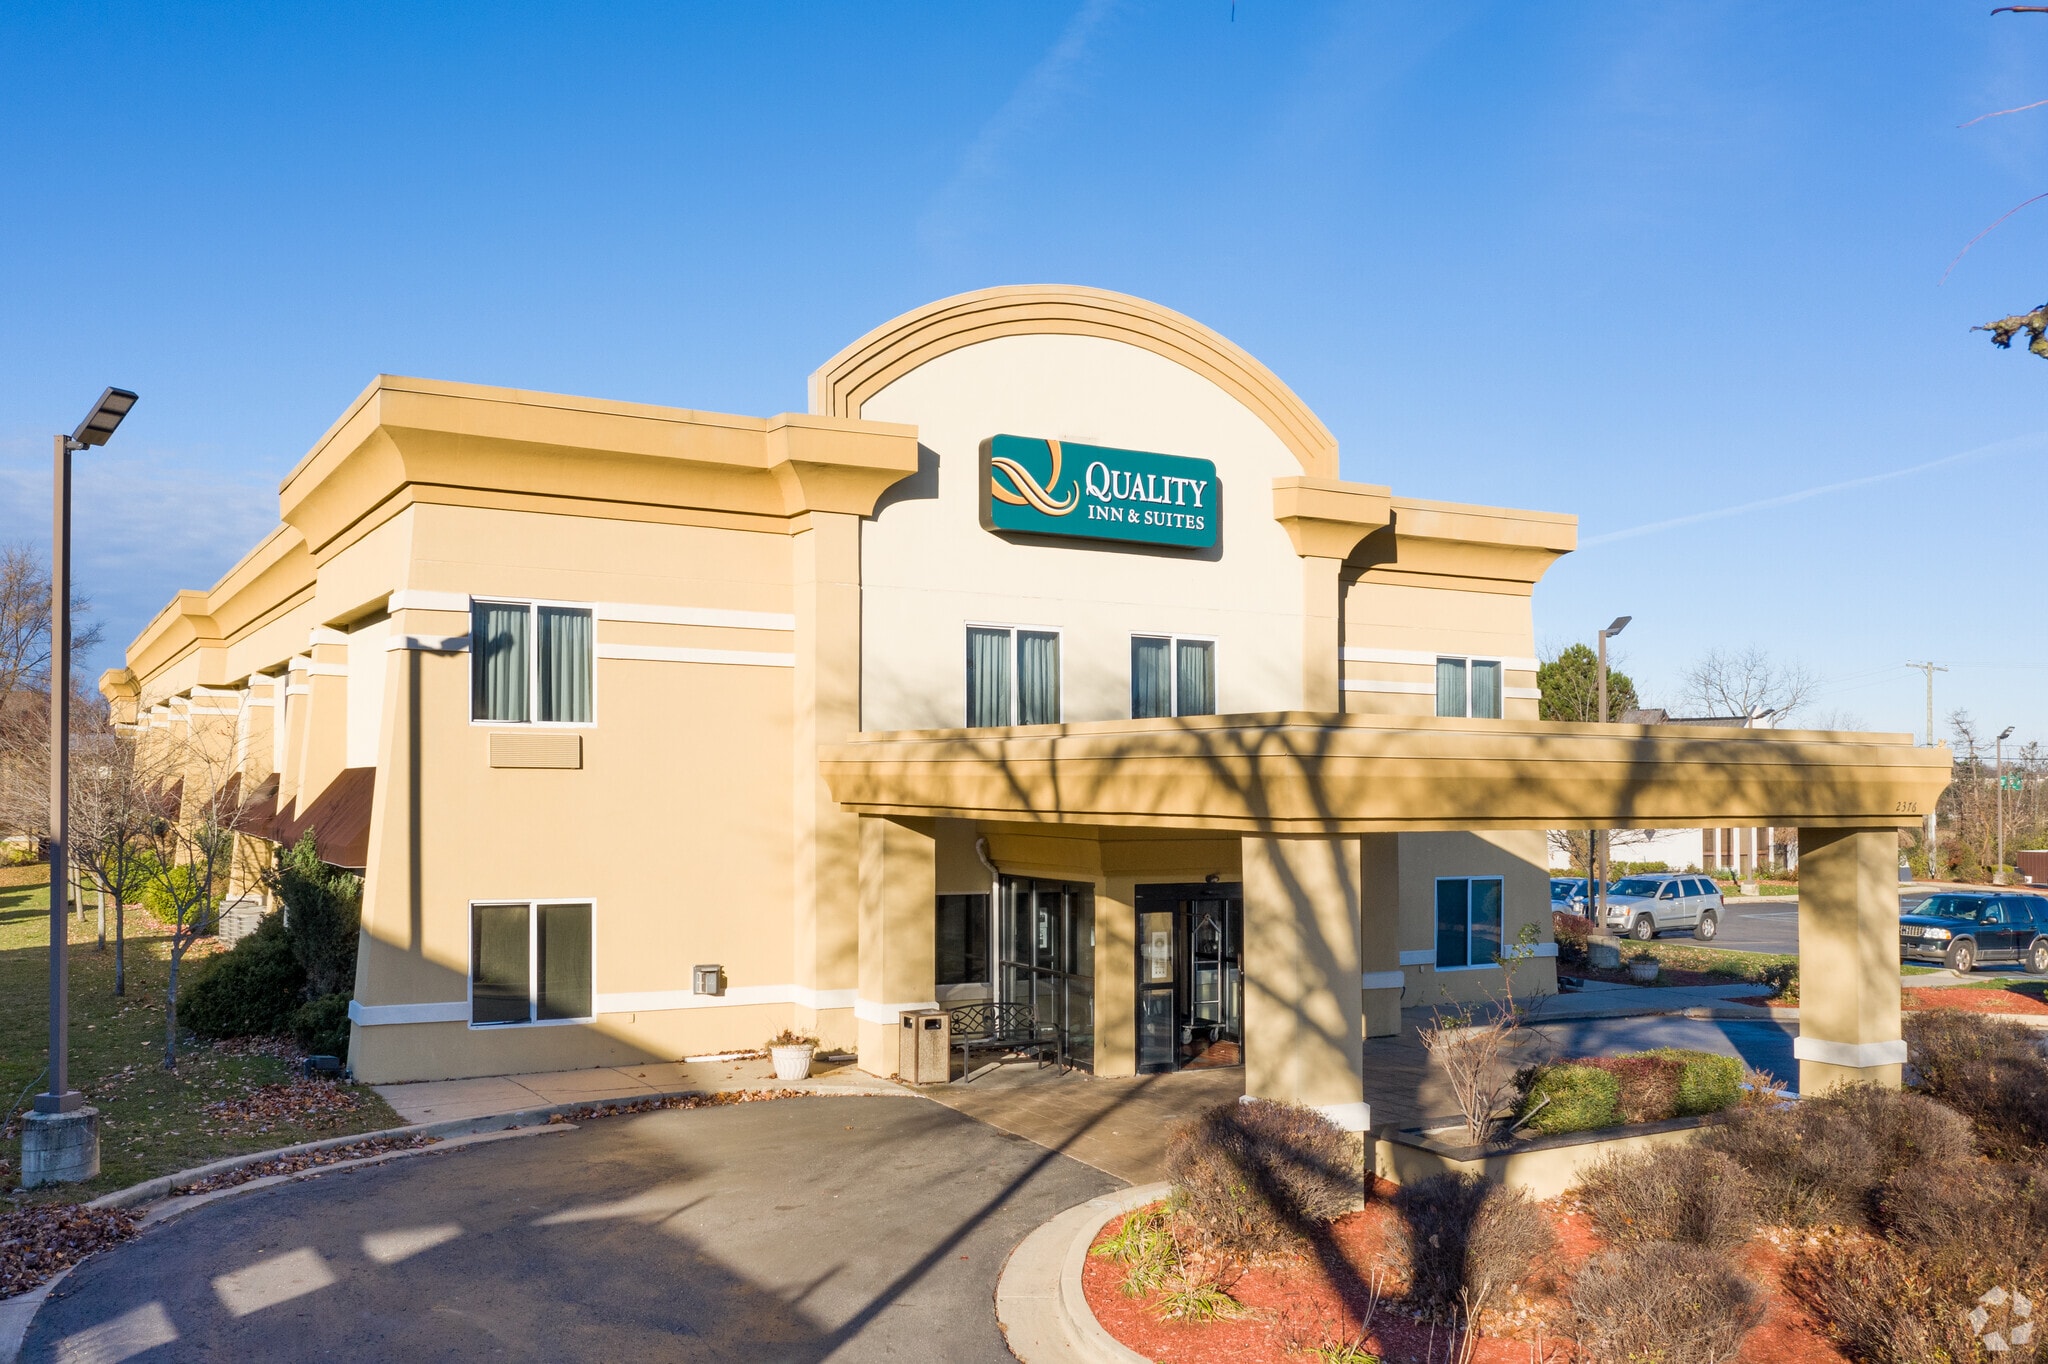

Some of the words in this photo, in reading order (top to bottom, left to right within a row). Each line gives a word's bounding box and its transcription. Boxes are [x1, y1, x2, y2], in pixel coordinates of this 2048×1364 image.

[1085, 461, 1208, 508] QUALITY
[1088, 505, 1123, 523] INN
[1128, 509, 1140, 524] &
[1144, 510, 1205, 530] SUITES
